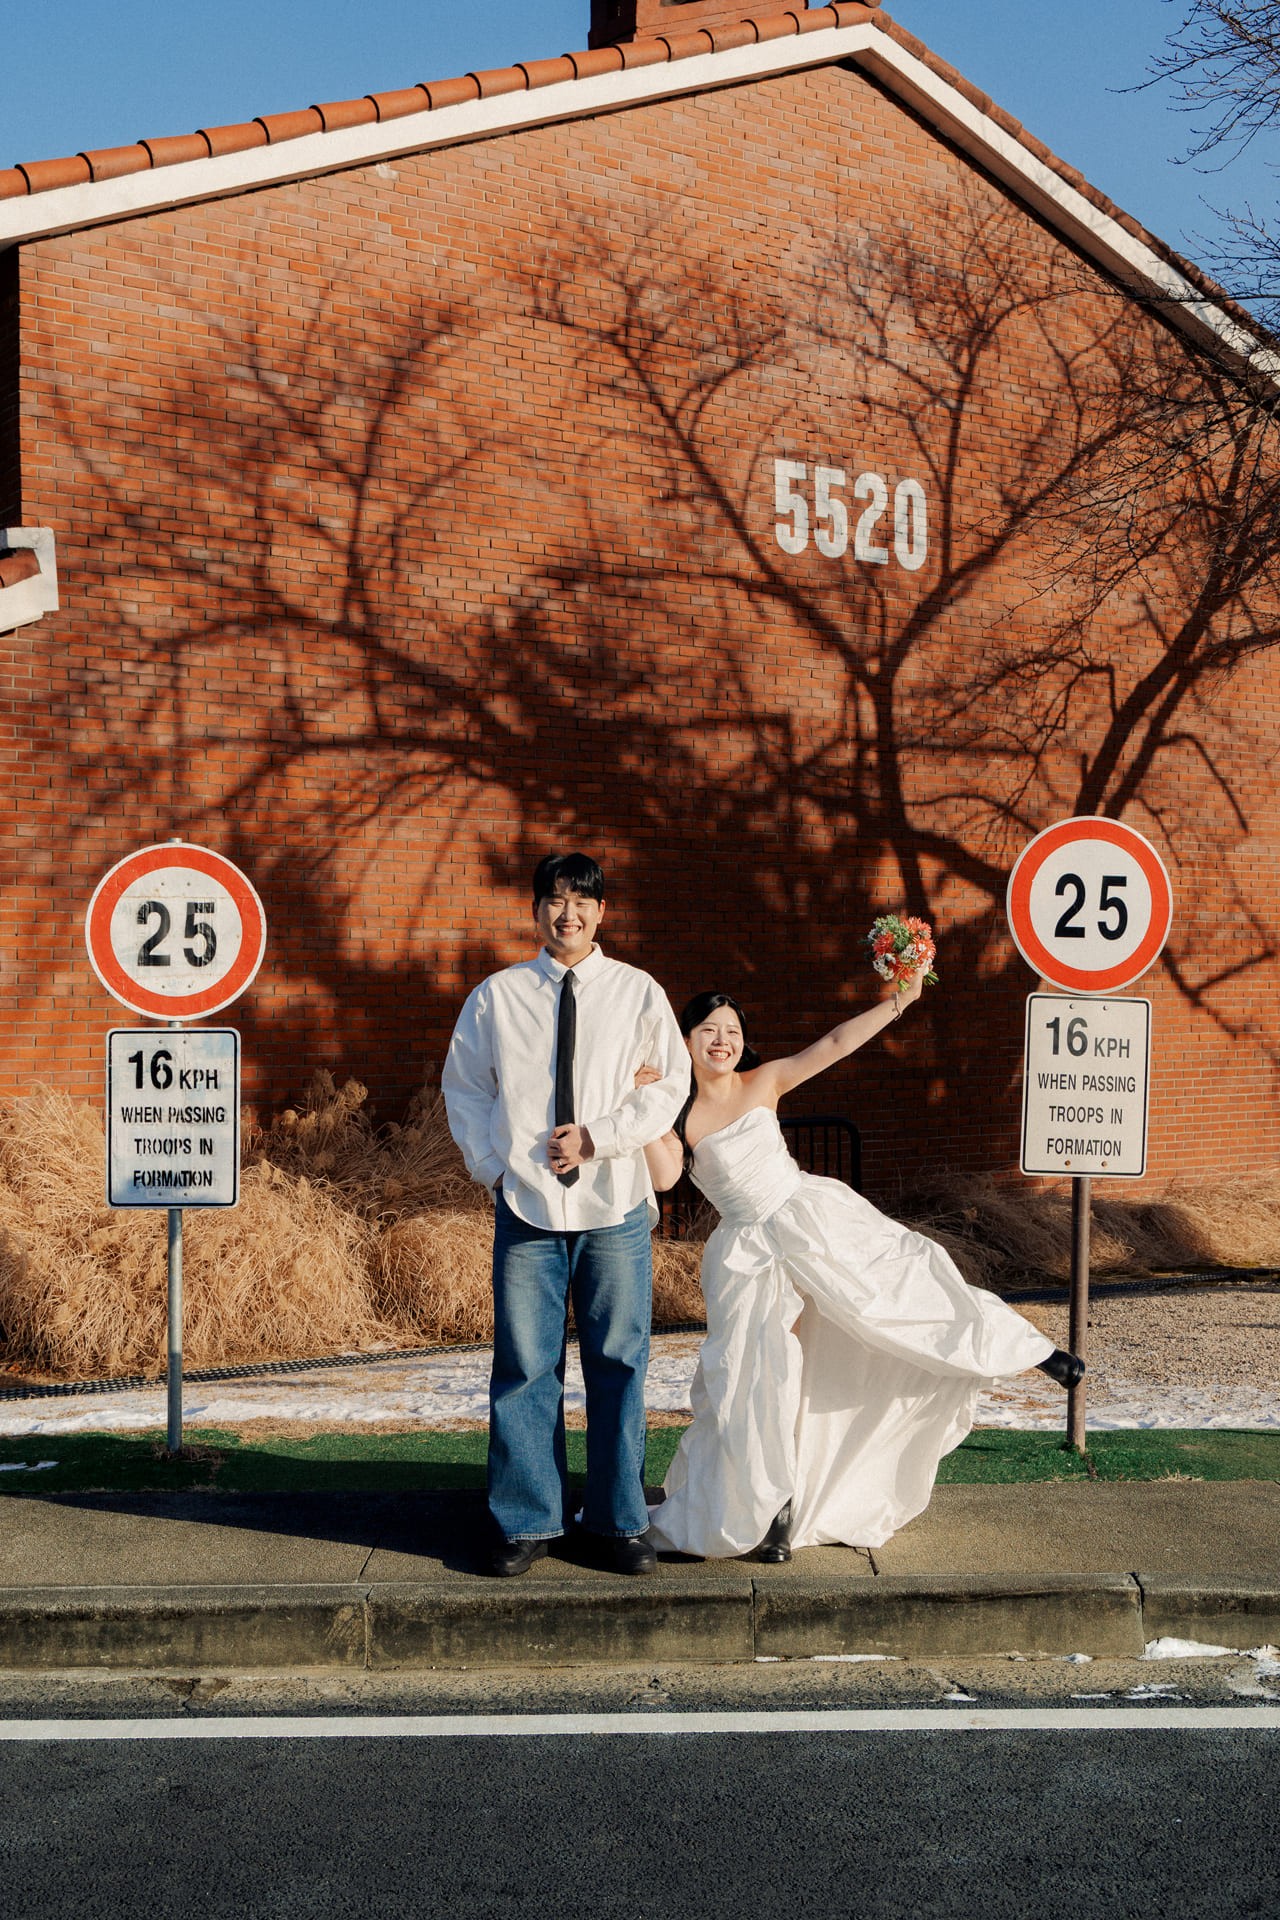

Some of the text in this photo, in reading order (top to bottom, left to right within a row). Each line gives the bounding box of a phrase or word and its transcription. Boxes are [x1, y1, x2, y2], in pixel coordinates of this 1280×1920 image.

[774, 458, 927, 571] 5520
[1054, 873, 1128, 941] 25
[136, 901, 217, 967] 25
[1045, 1016, 1130, 1058] 16 KPH
[128, 1050, 219, 1090] 16 KPH
[1038, 1072, 1136, 1093] WHEN PASSING
[121, 1106, 225, 1123] WHEN PASSING
[1049, 1105, 1123, 1125] TROOPS IN
[134, 1138, 213, 1155] TROOPS IN
[1046, 1138, 1121, 1157] FORMATION
[133, 1170, 212, 1187] FORMATION
